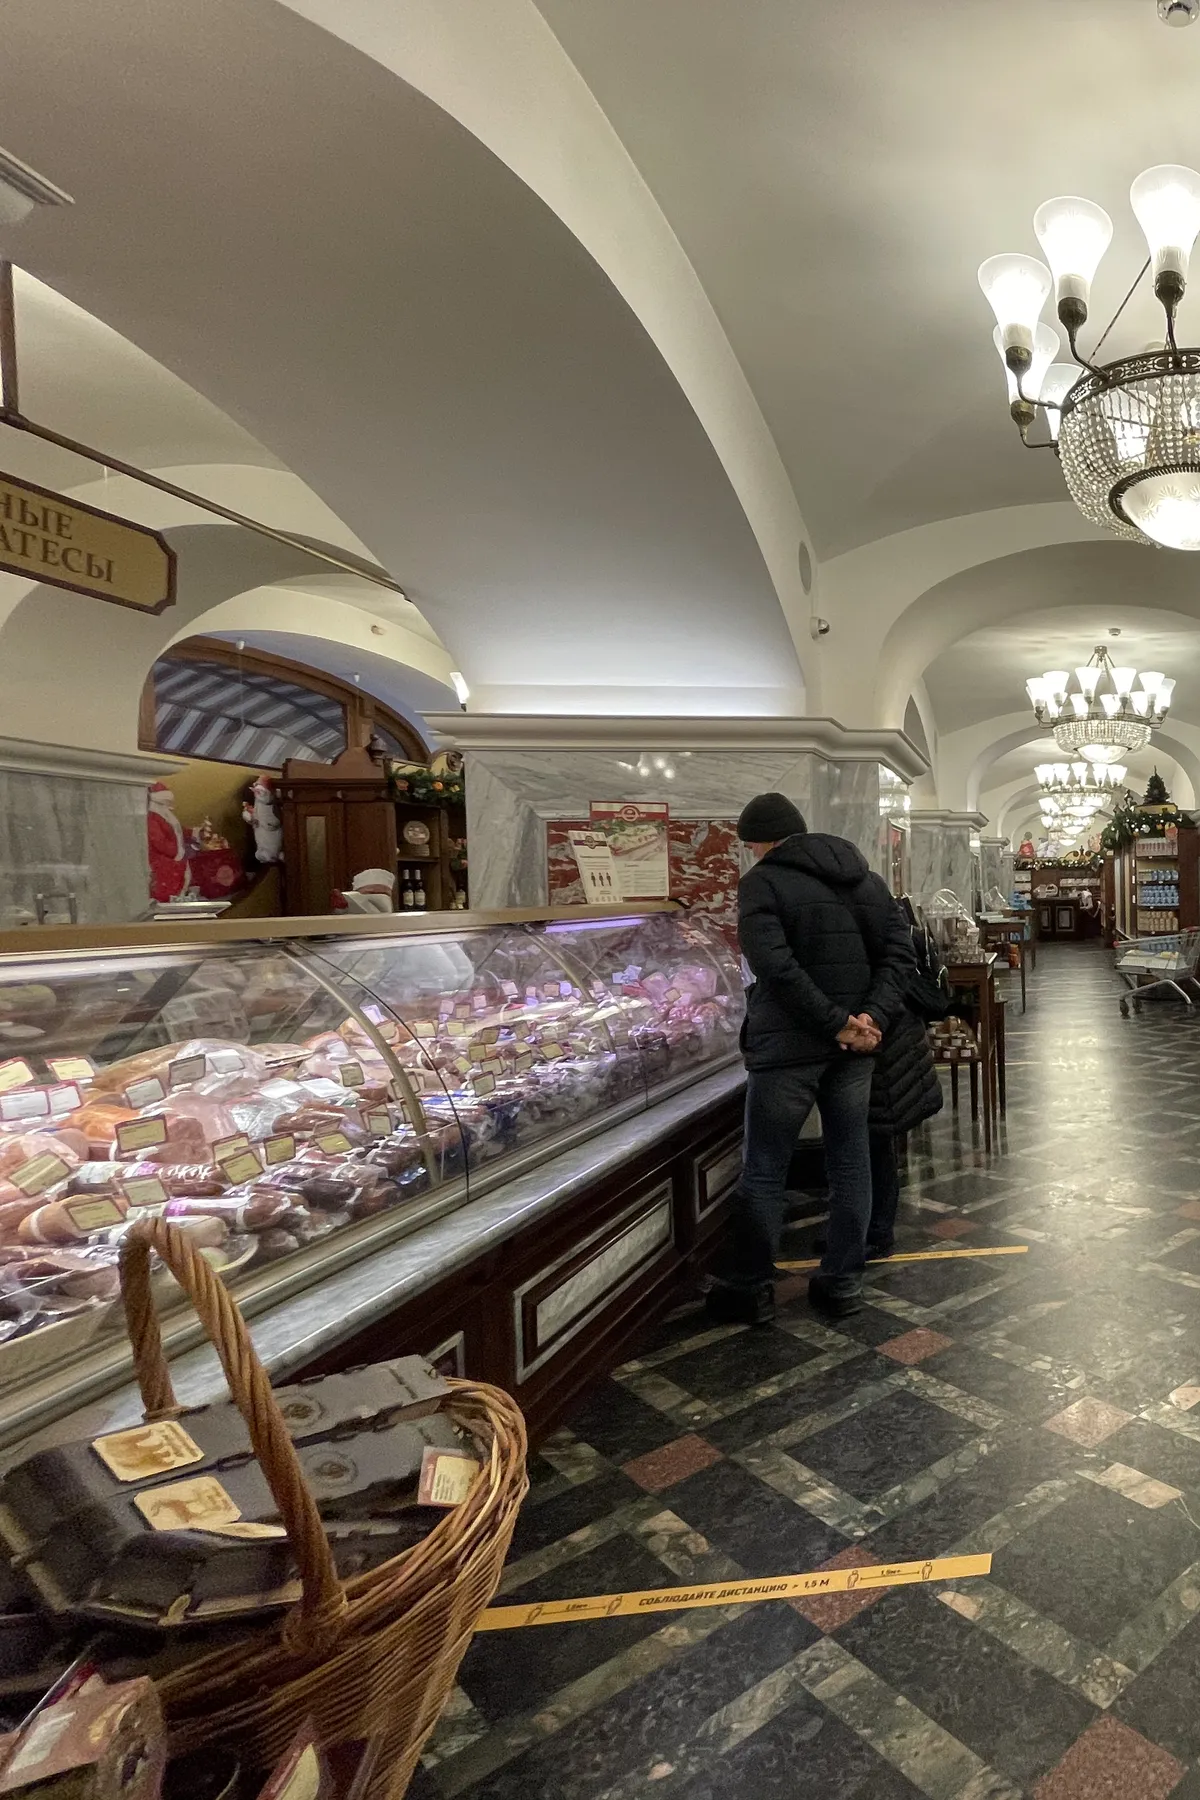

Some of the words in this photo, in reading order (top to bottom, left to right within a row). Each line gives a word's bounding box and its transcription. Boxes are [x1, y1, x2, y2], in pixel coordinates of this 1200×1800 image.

[638, 1590, 716, 1607] СОБЛЮДАЙТЕ
[717, 1583, 788, 1600] ДИСТАНЦИЮ
[804, 1579, 817, 1589] 1,5
[819, 1578, 830, 1587] М
